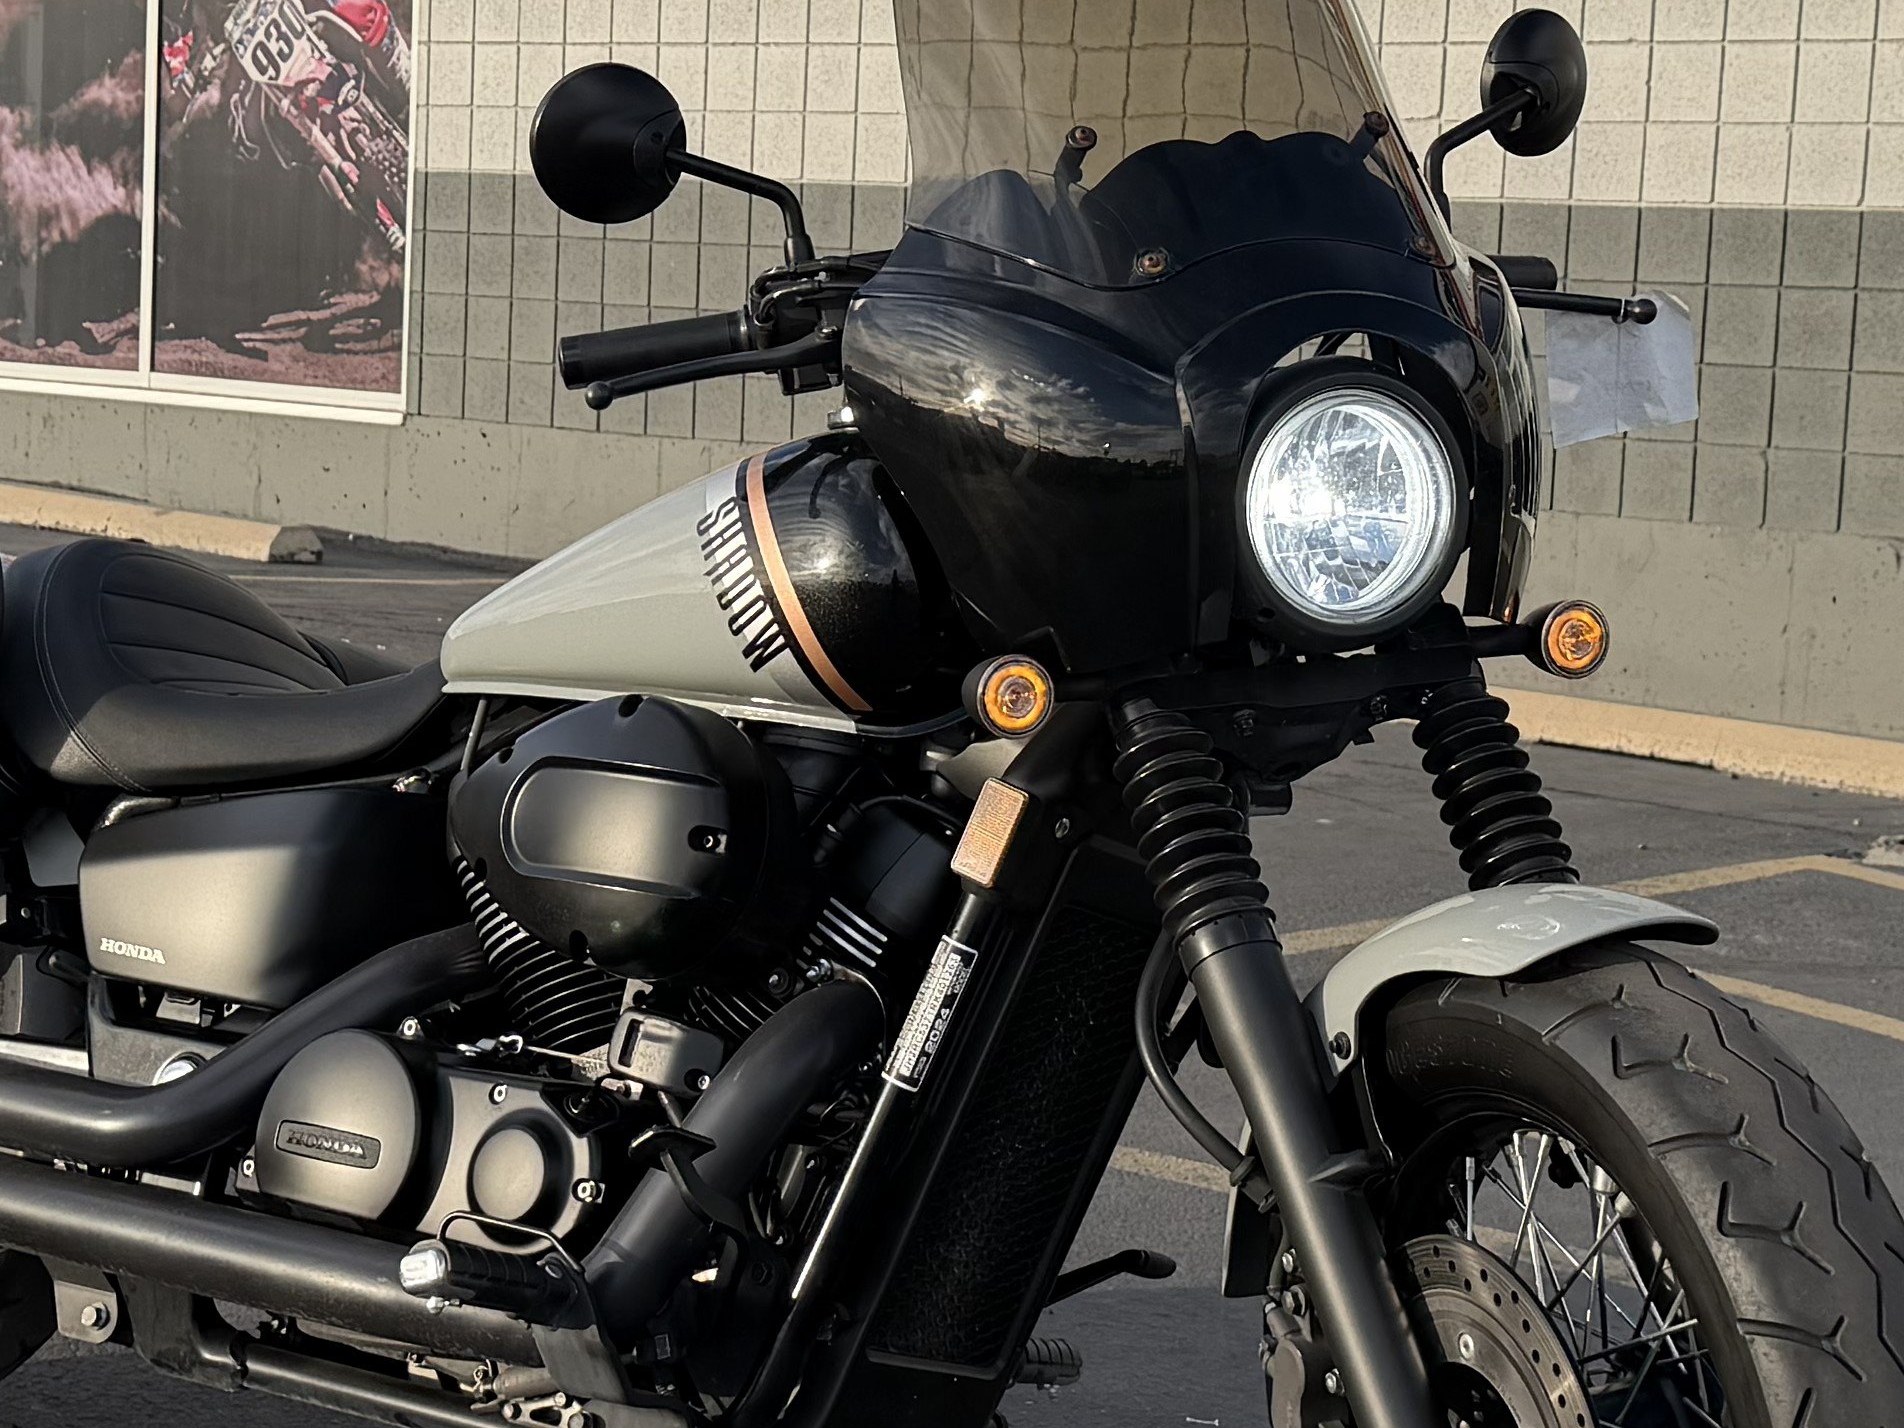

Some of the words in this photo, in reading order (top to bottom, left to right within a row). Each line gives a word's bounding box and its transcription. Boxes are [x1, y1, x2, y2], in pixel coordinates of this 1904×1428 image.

[696, 496, 790, 673] SHADOW
[99, 937, 166, 965] HONDA
[924, 1008, 950, 1054] 2024
[286, 1129, 367, 1160] HONDA
